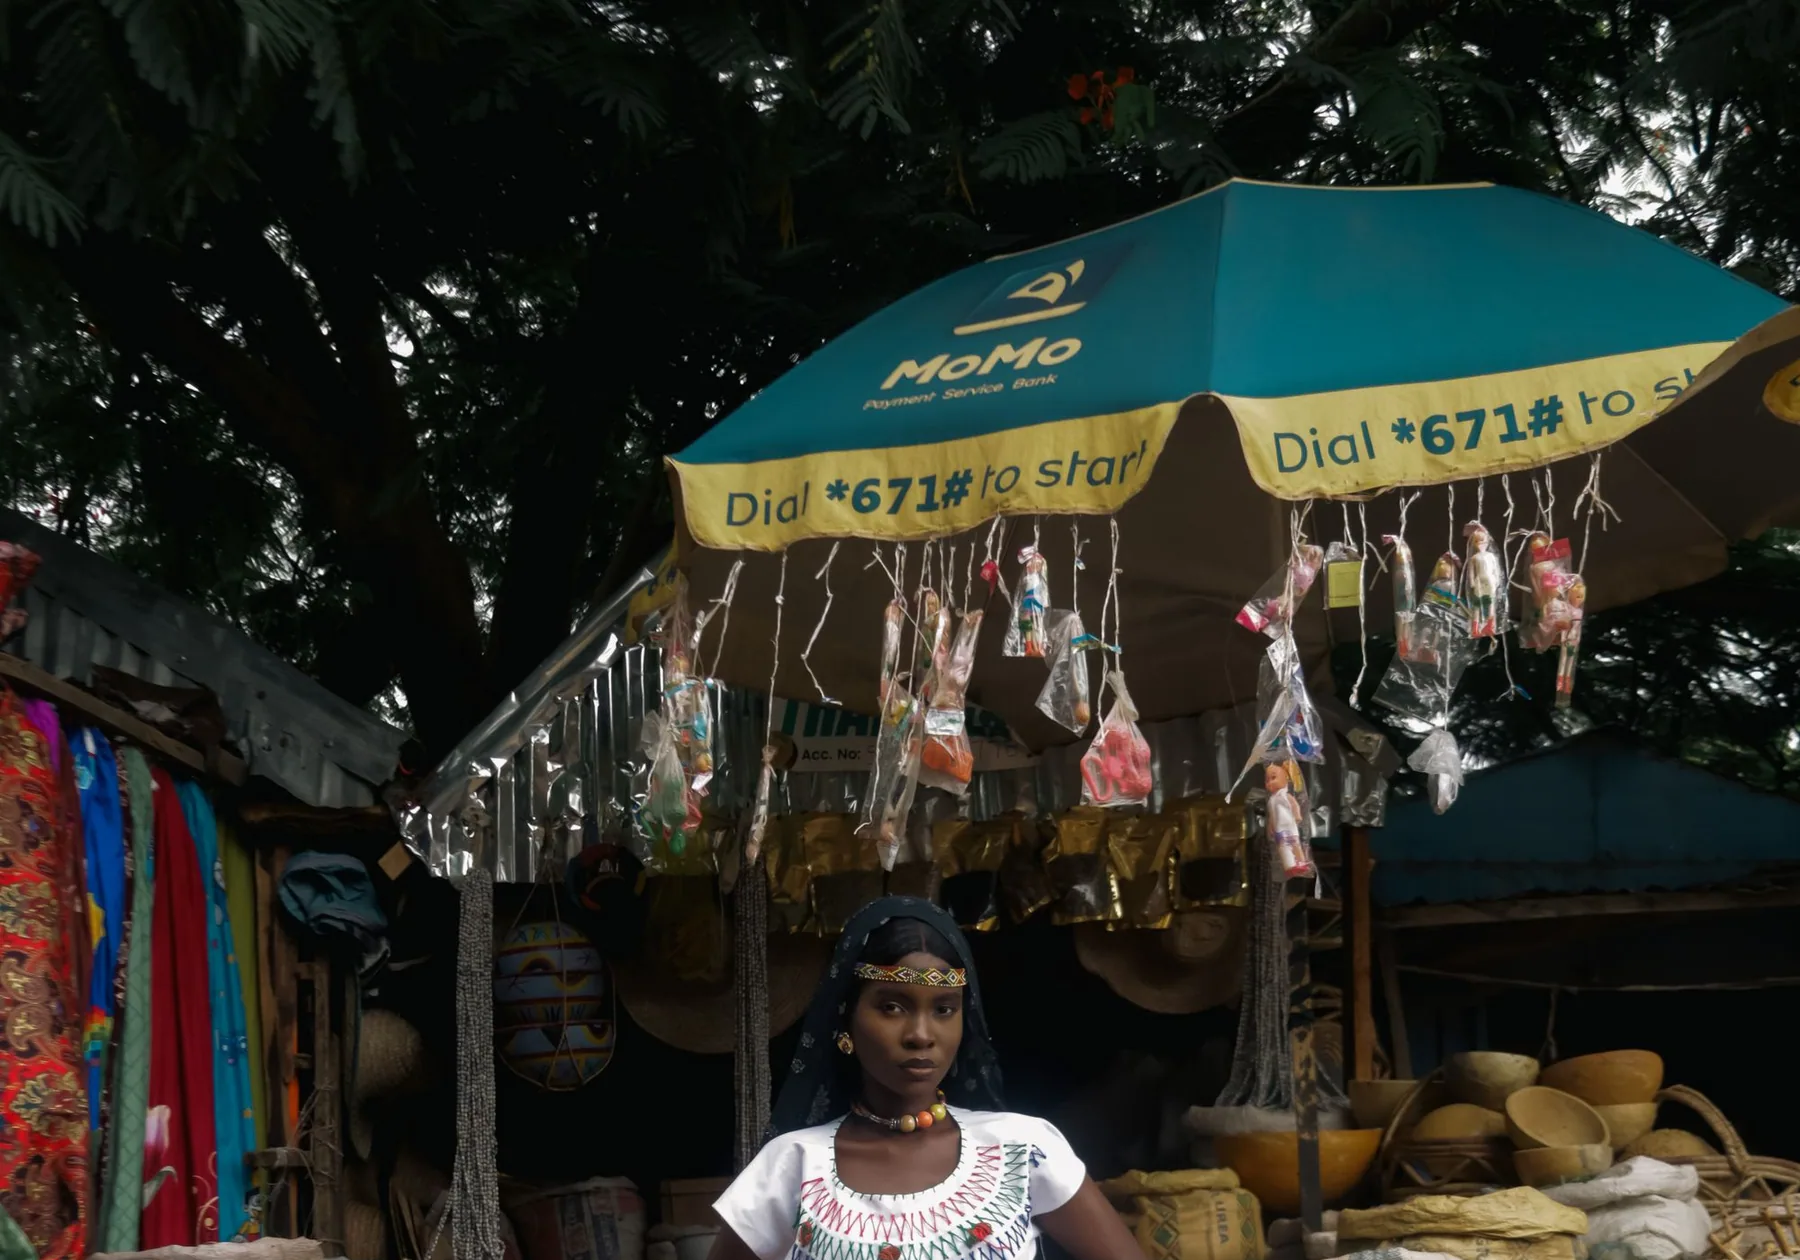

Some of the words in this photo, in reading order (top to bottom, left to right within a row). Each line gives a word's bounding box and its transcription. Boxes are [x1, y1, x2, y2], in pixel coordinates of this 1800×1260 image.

[880, 337, 1082, 390] MoMo
[862, 391, 936, 410] Payment
[942, 382, 1004, 400] Service
[1012, 373, 1058, 390] Bank
[1273, 420, 1376, 473] Dial
[1579, 390, 1635, 425] to
[726, 480, 809, 527] Dial
[981, 464, 1020, 499] to
[802, 748, 832, 761] Acc.
